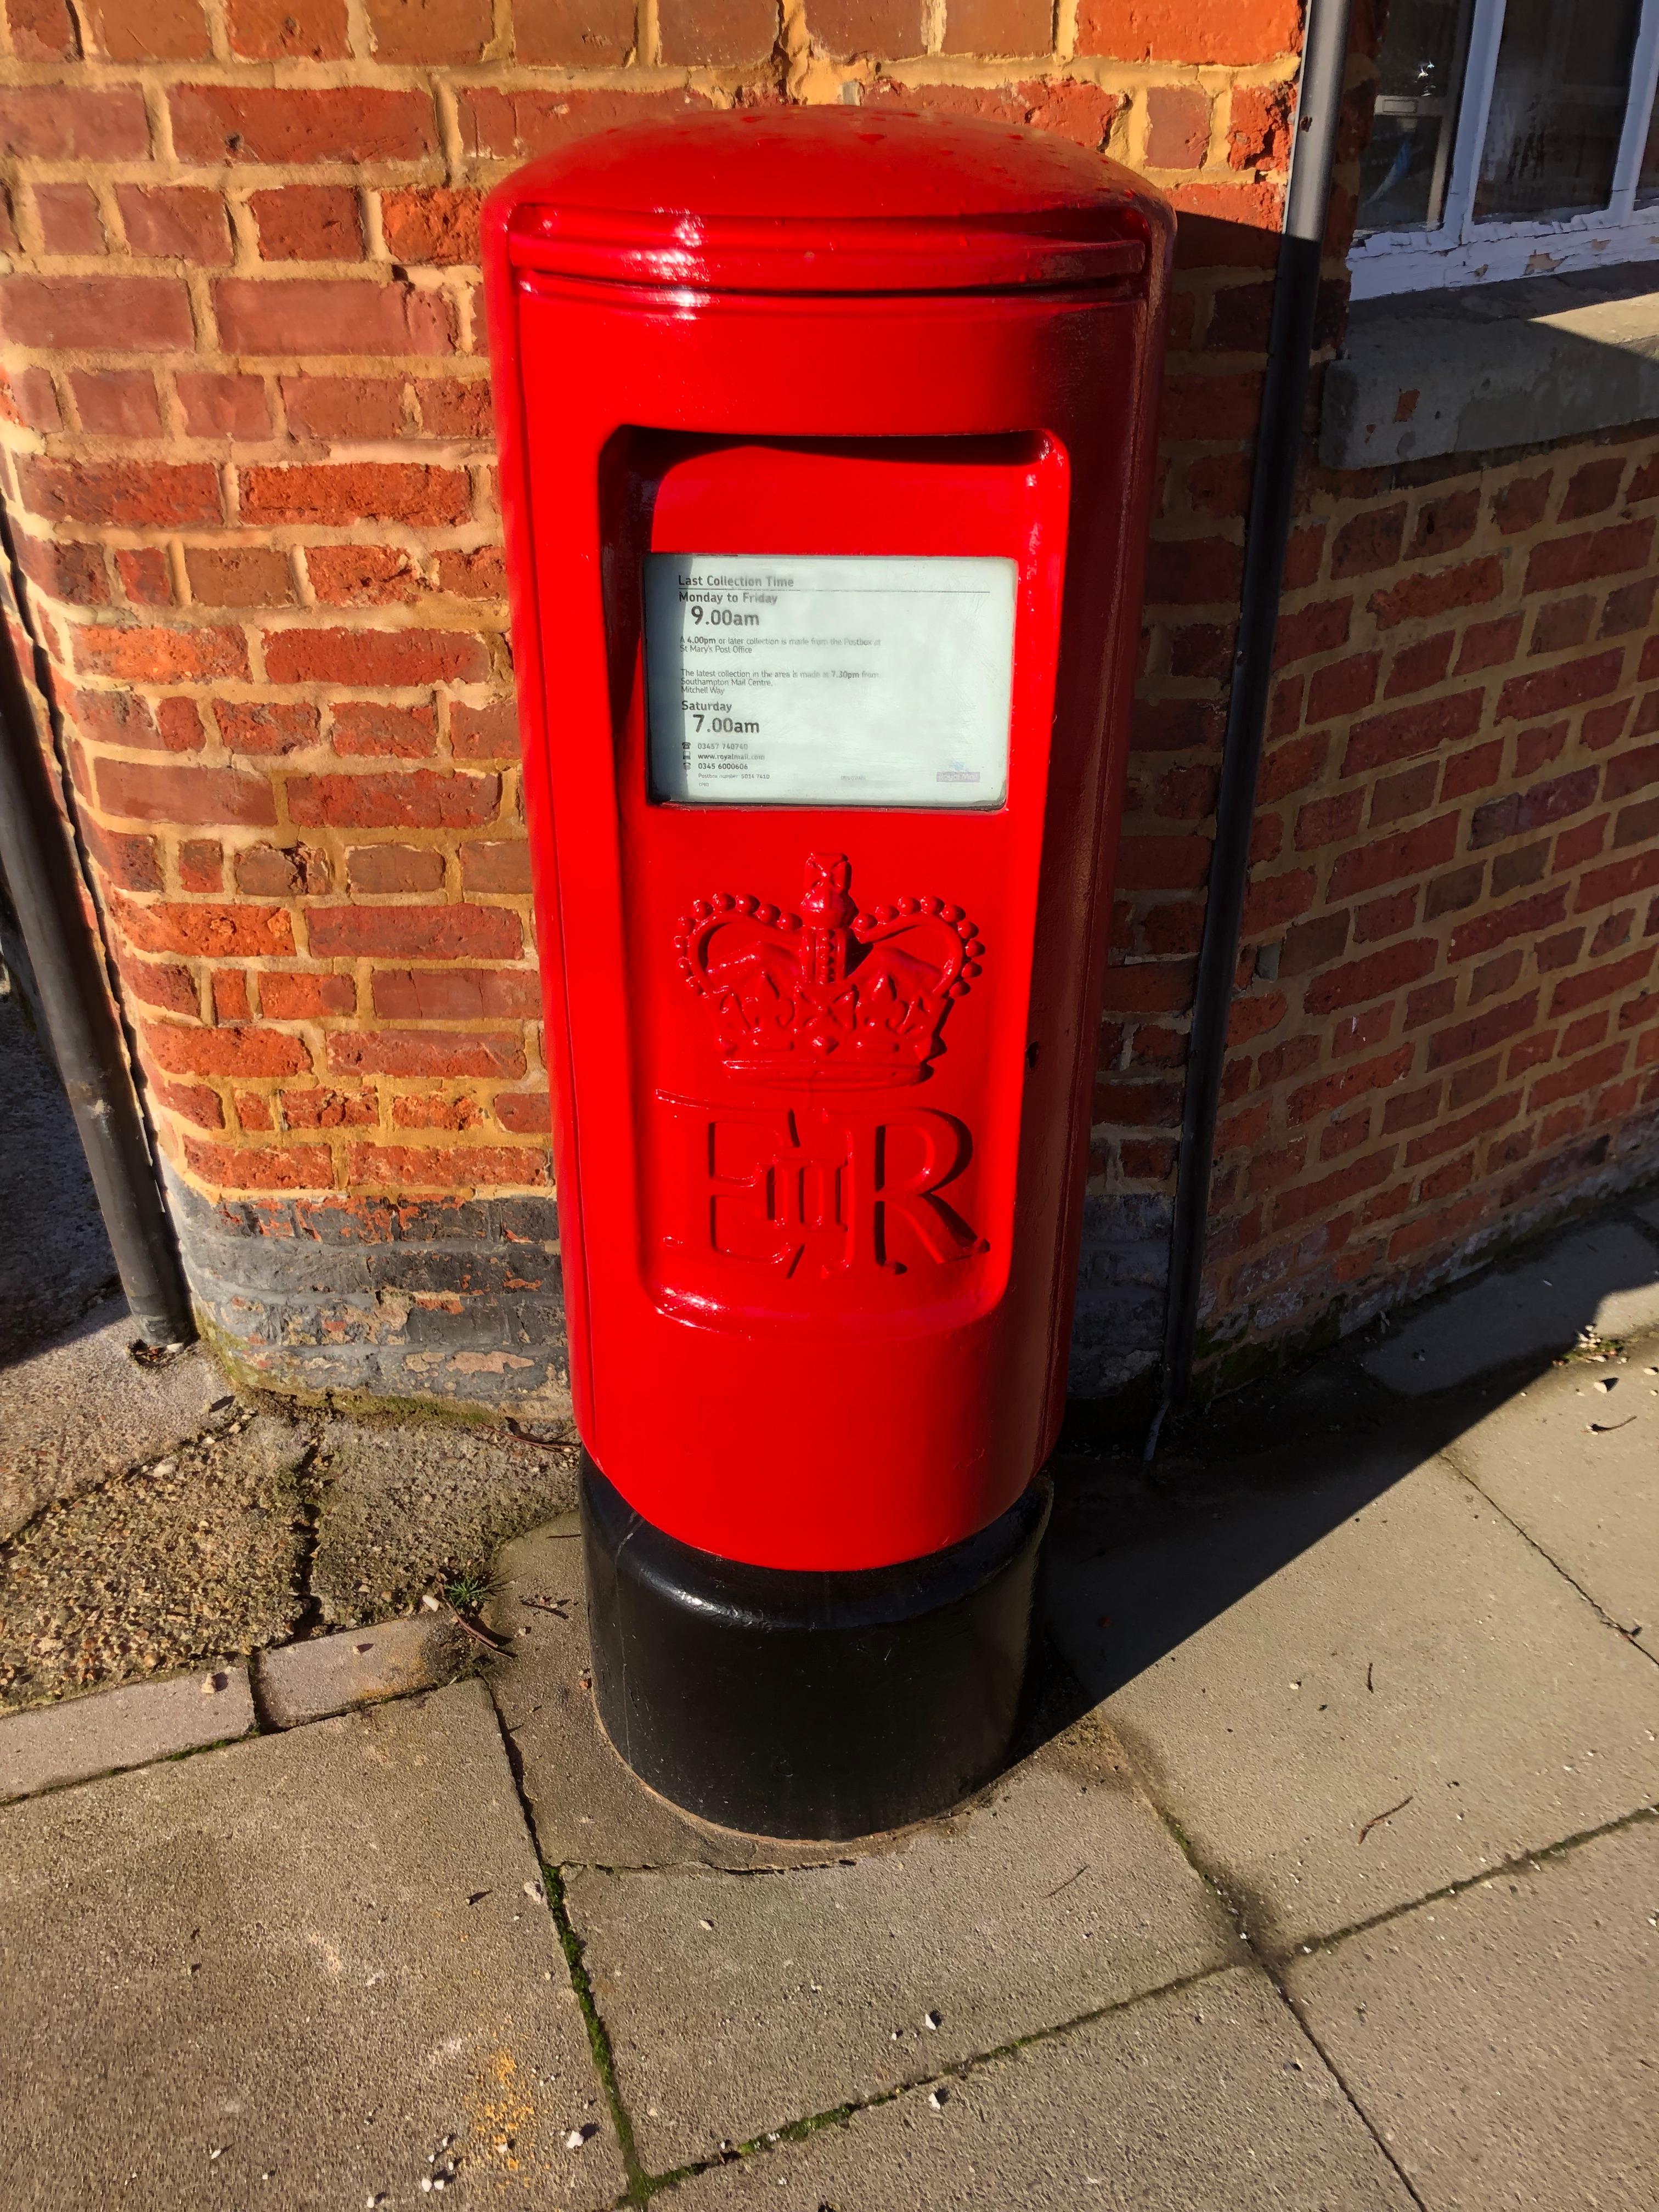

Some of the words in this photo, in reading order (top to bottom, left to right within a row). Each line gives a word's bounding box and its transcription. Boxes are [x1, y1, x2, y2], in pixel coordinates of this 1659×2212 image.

[679, 575, 703, 585] Last
[707, 575, 762, 586] Collection
[766, 577, 794, 586] Time
[679, 591, 723, 604] Monday
[727, 593, 738, 602] to
[743, 592, 778, 605] Friday
[691, 605, 759, 626] 9.00am
[687, 636, 716, 645] 4.00pm
[690, 645, 713, 654] Mary's
[831, 671, 859, 679] 7.30pm
[681, 678, 729, 686] Southampton
[710, 687, 724, 696] Way
[681, 701, 732, 713] Saturday
[693, 714, 759, 733] 7.00am
